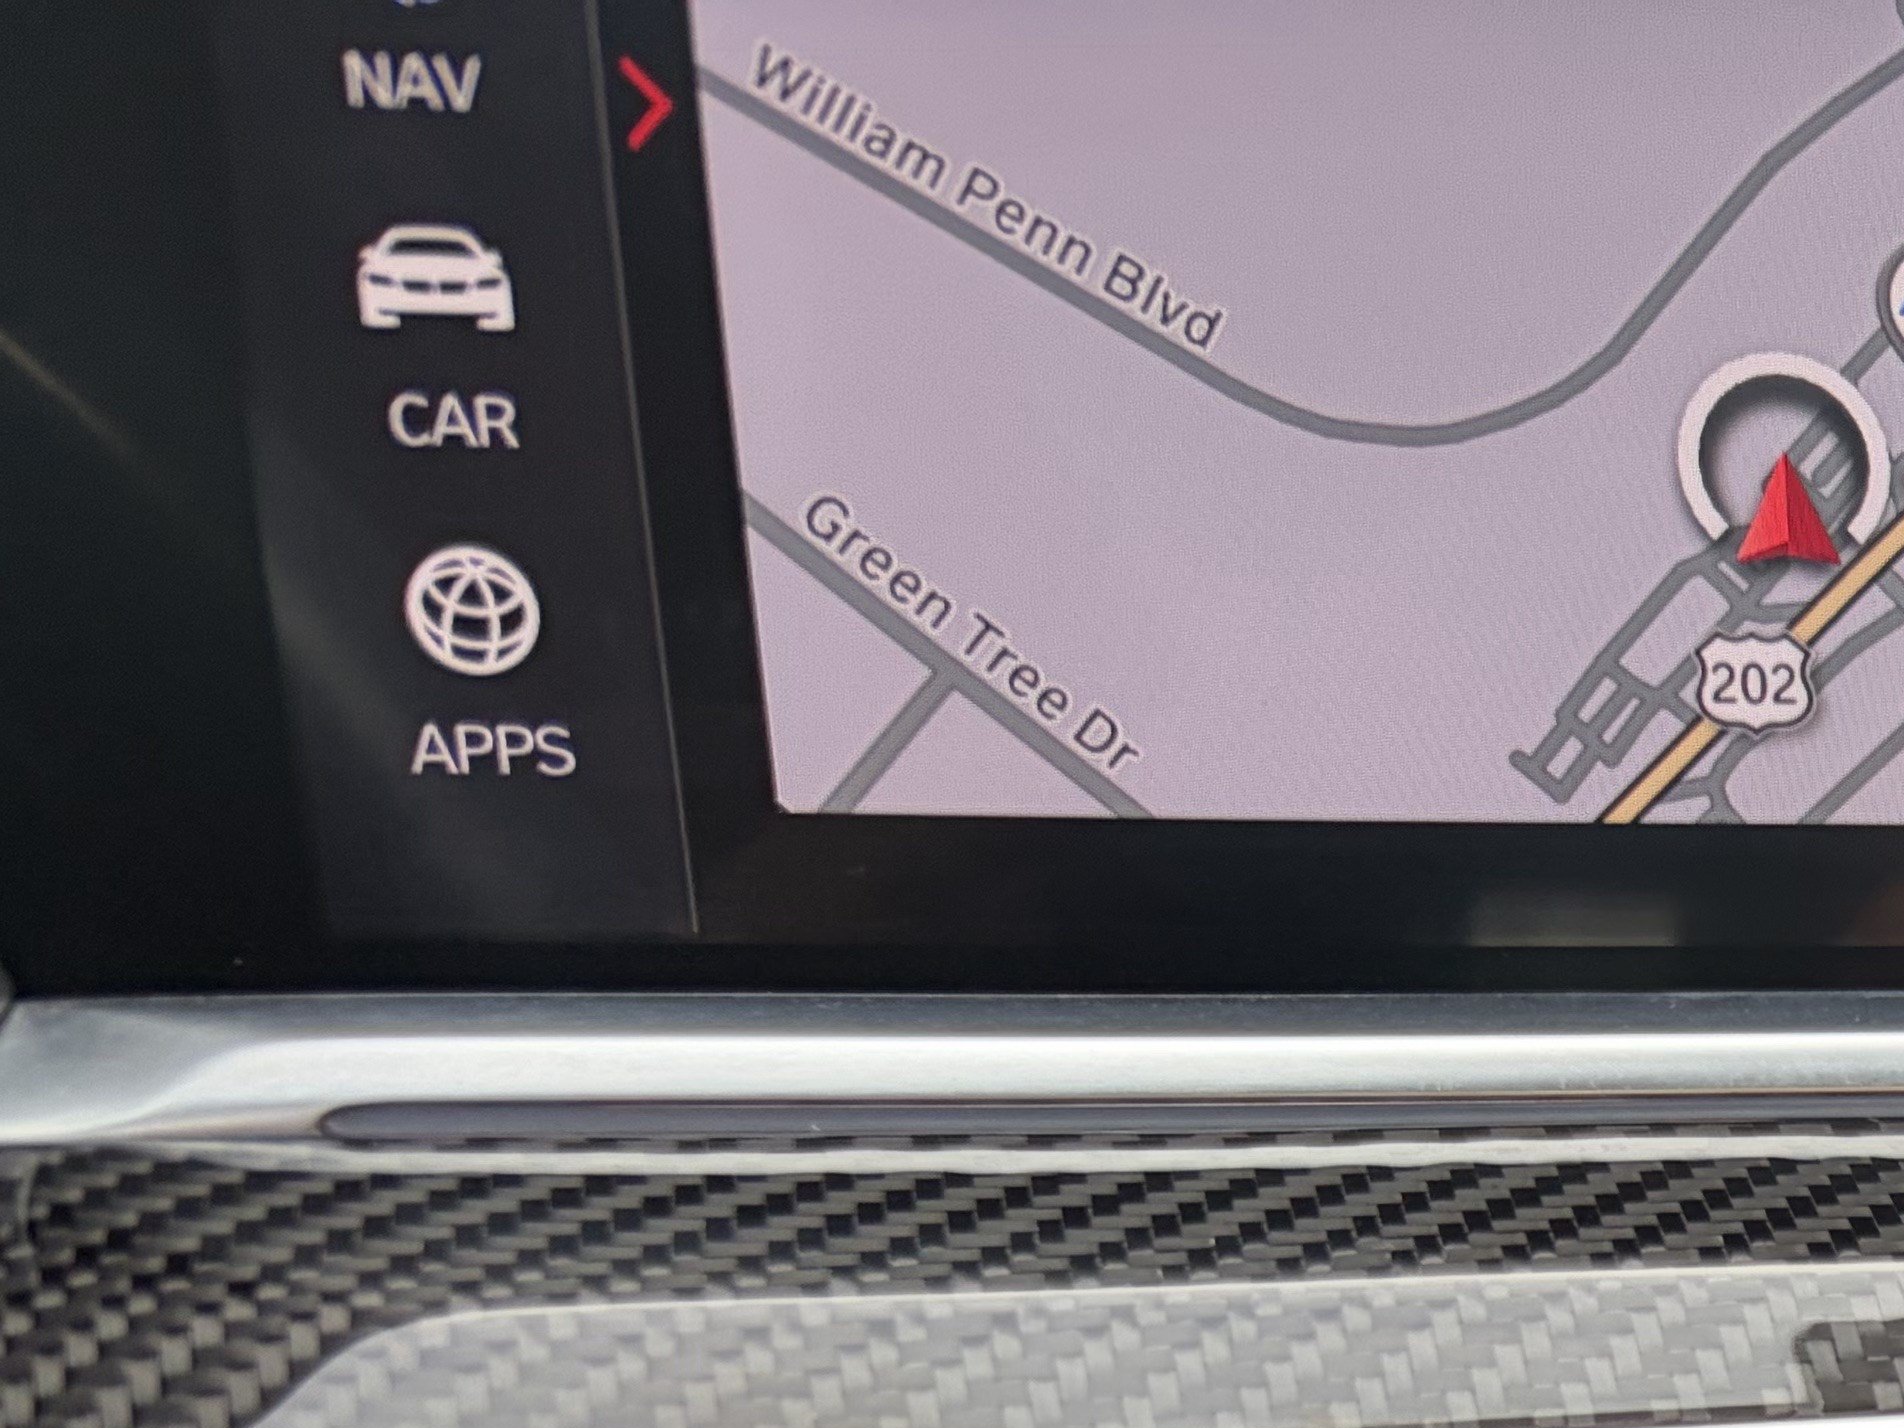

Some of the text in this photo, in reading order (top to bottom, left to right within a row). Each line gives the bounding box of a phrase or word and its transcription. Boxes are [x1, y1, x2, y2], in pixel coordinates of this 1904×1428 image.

[342, 49, 481, 112] NAV
[755, 44, 1224, 348] William Penn Blvd
[388, 392, 520, 449] CAR
[805, 494, 1140, 772] Green Tree Dr
[1711, 663, 1798, 706] 202
[411, 722, 576, 776] APPS
